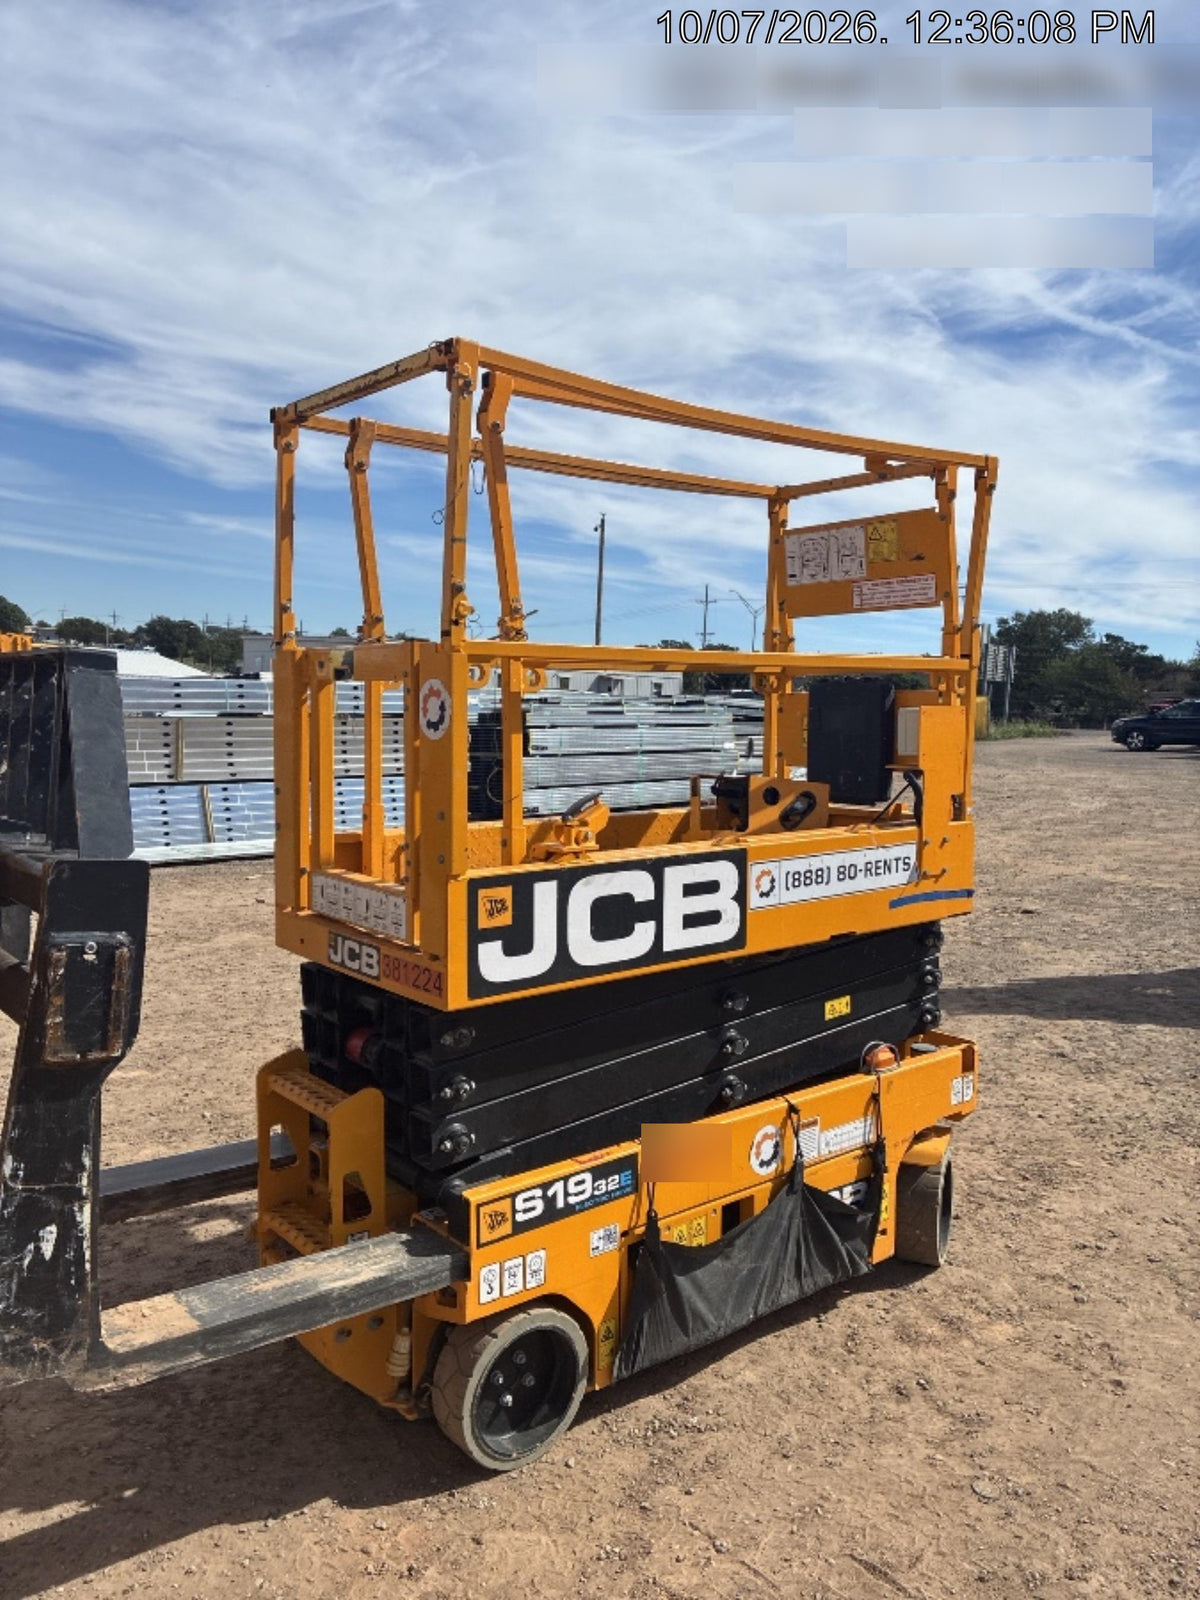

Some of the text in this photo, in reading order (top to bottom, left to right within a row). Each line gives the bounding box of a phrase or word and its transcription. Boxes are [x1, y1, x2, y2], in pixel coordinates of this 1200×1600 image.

[785, 856, 911, 891] (888) 80-RENTS
[477, 861, 740, 982] JCB
[328, 936, 380, 978] JCB
